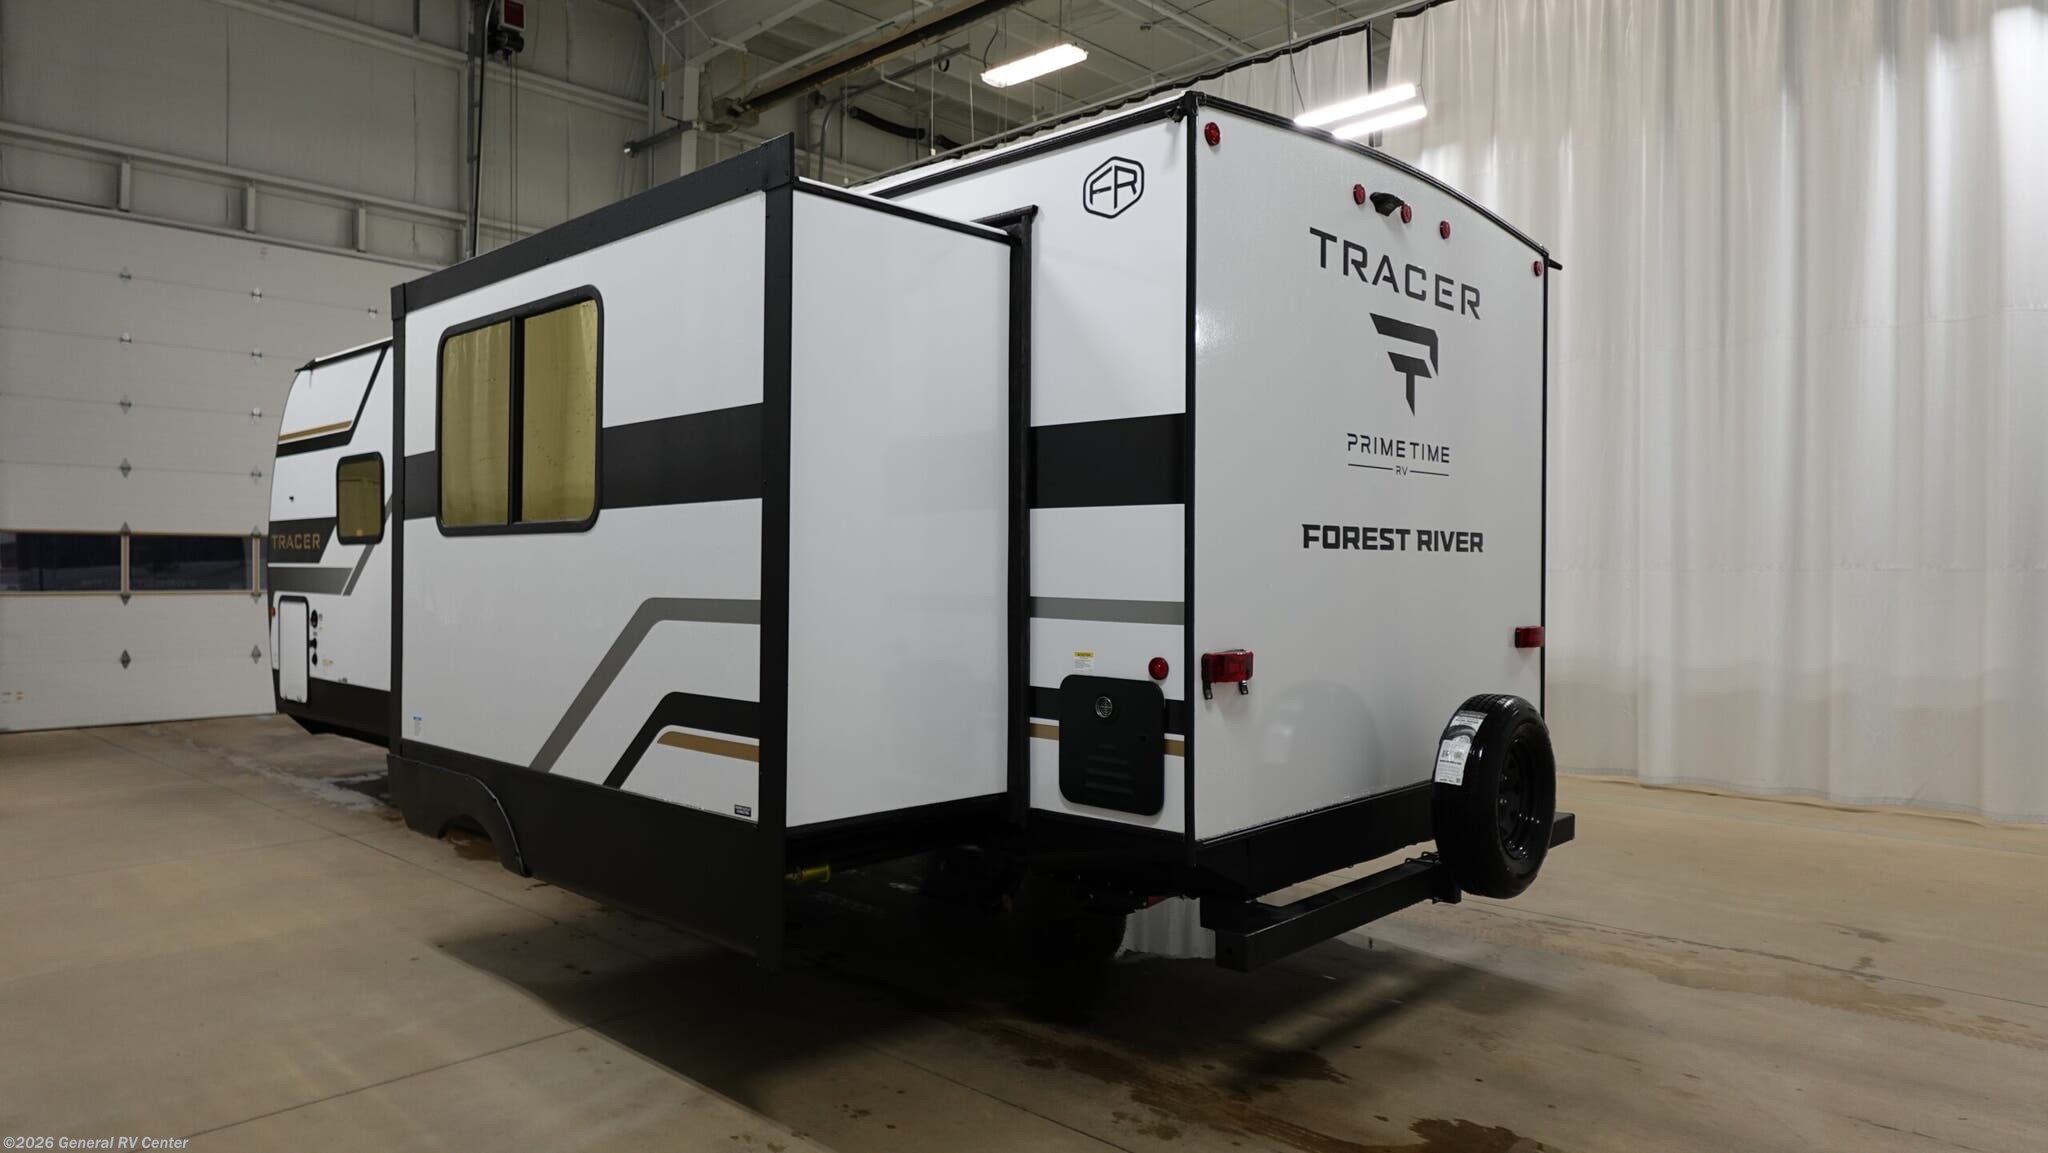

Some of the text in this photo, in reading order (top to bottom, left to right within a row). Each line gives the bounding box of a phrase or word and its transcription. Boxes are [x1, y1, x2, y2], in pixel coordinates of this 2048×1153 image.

[1309, 226, 1481, 320] TRACER
[1395, 465, 1408, 476] RV
[271, 533, 321, 550] TRACER
[1302, 523, 1484, 553] FOREST RIVER
